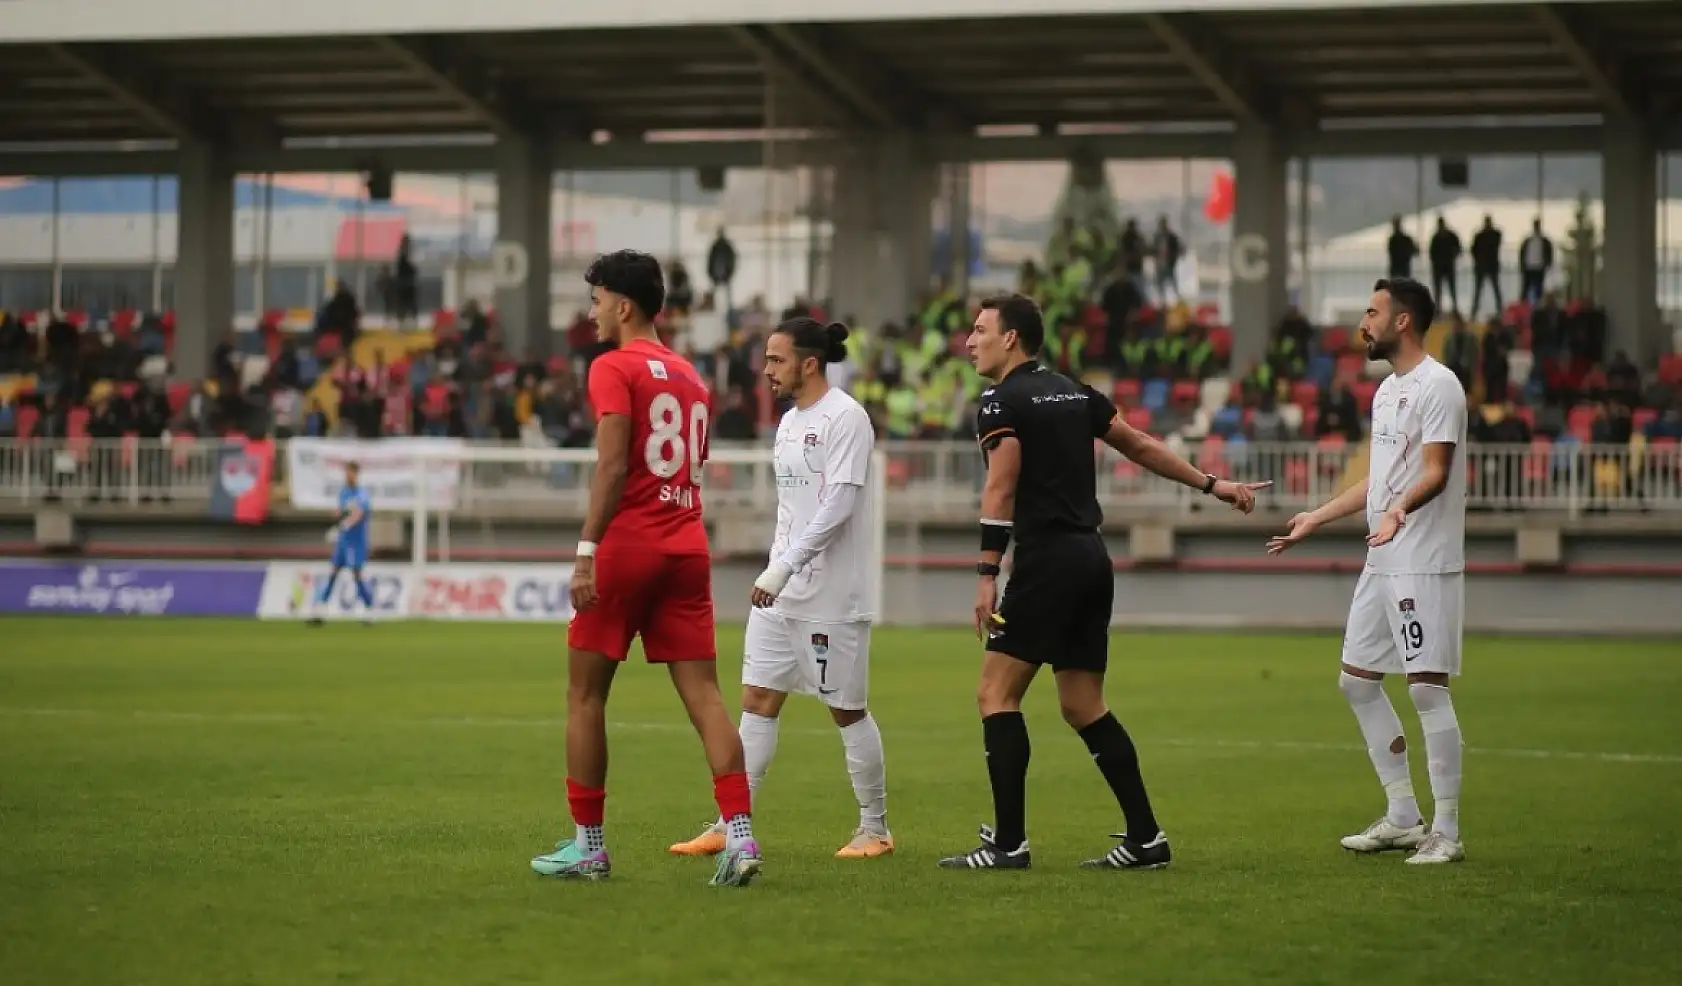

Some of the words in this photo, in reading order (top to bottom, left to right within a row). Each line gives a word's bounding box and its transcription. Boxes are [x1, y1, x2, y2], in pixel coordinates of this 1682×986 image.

[492, 243, 528, 286] D
[1233, 233, 1269, 281] C
[644, 392, 708, 486] 80
[1401, 621, 1423, 650] 19
[816, 658, 828, 684] 7
